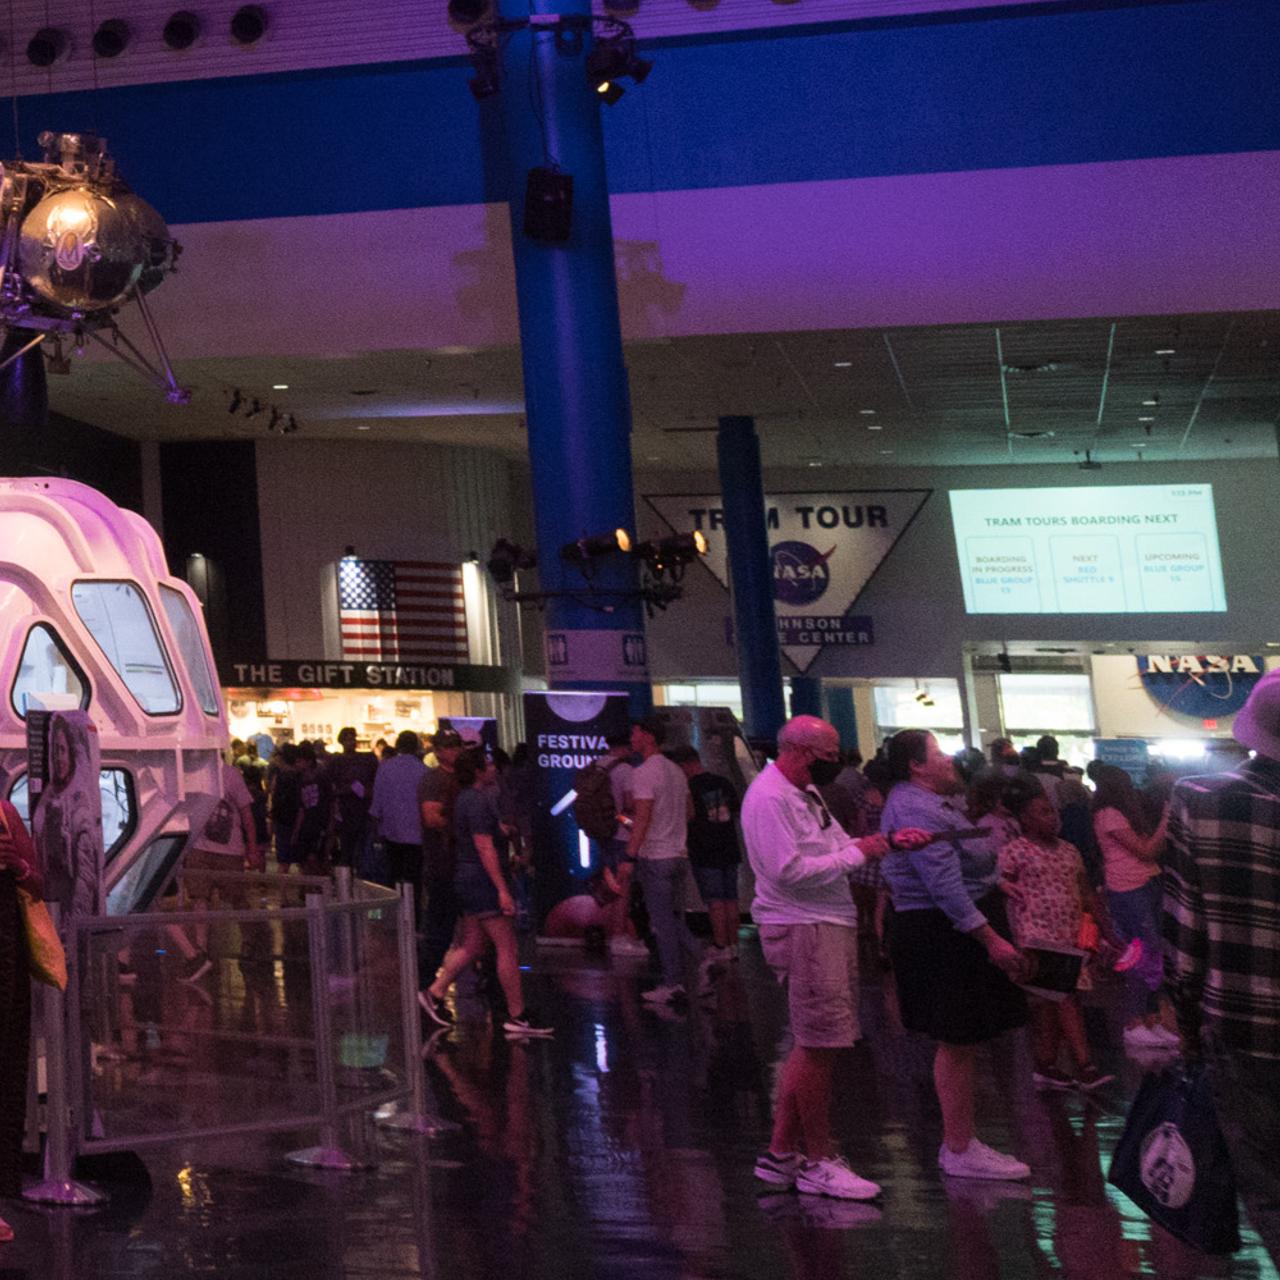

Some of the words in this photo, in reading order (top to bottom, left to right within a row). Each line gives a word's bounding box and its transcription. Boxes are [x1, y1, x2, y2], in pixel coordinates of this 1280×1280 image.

[689, 507, 781, 531] TR
[795, 505, 890, 530] TOUR
[984, 517, 1022, 527] TRAM
[1026, 515, 1068, 527] TOURS
[1071, 514, 1141, 526] BOARDING
[1144, 513, 1179, 525] NEXT
[778, 618, 842, 631] HNSON
[799, 631, 869, 644] CENTER
[1146, 655, 1260, 673] NASA
[233, 663, 282, 683] THE
[297, 664, 355, 685] GIFT
[366, 665, 455, 687] STATION
[537, 734, 609, 750] FESTIVA
